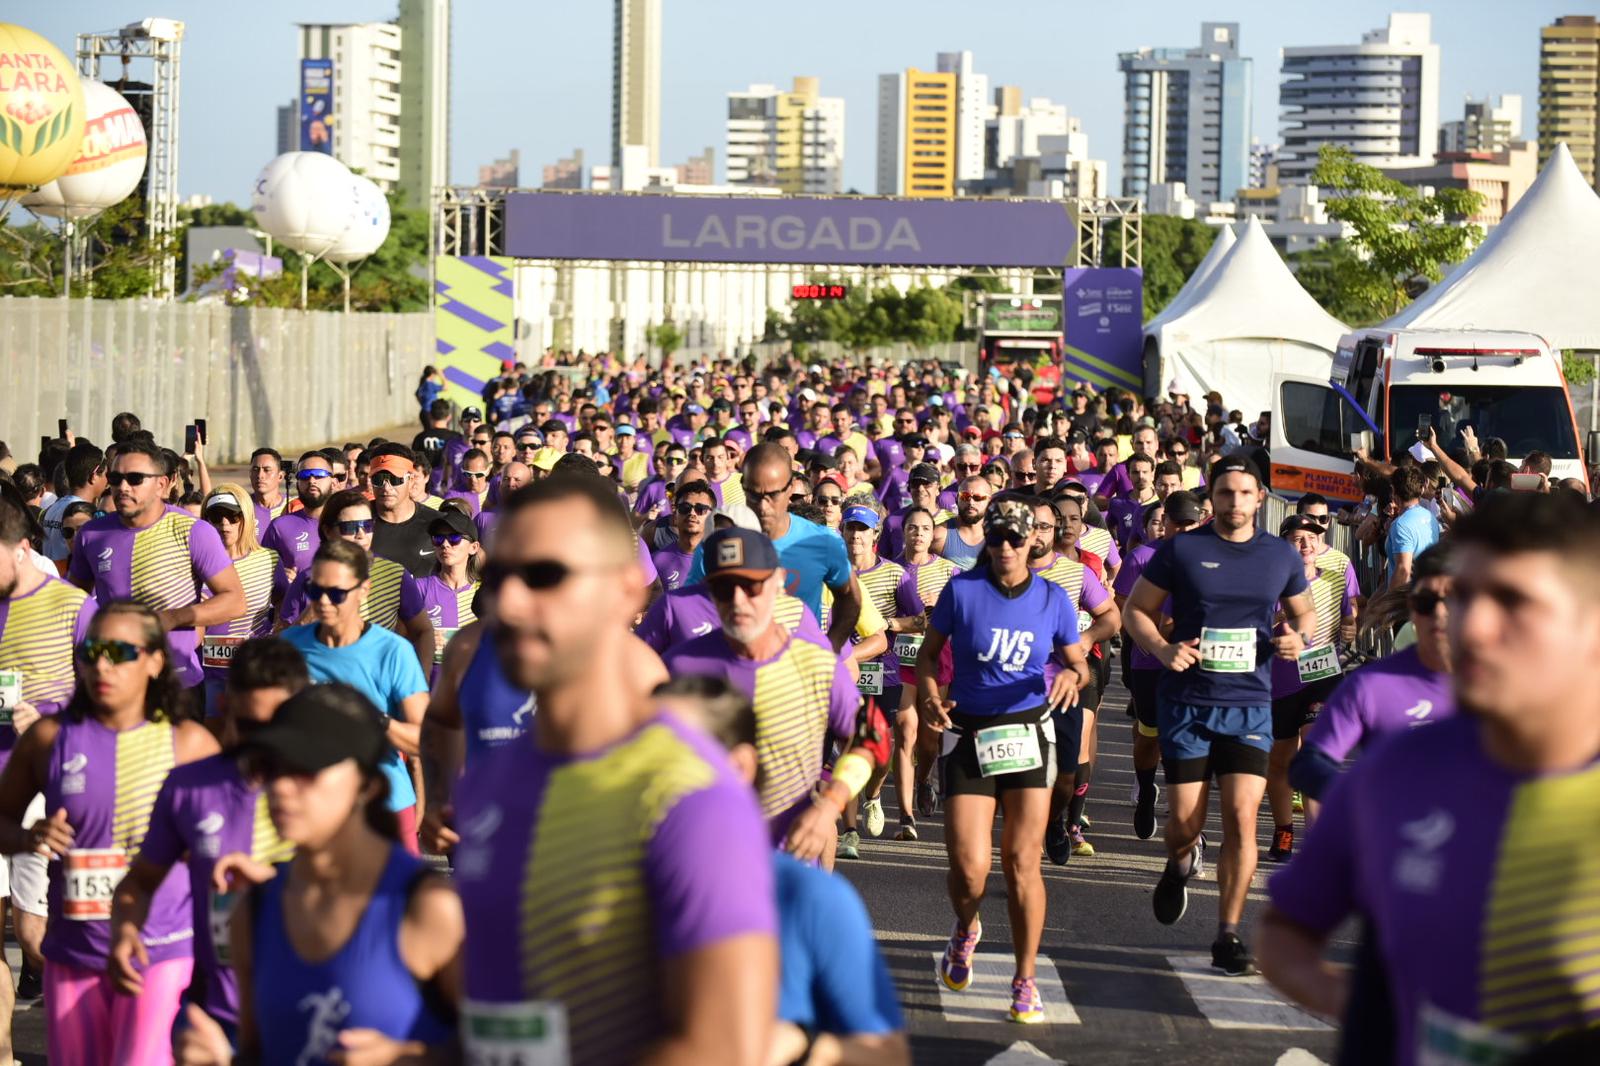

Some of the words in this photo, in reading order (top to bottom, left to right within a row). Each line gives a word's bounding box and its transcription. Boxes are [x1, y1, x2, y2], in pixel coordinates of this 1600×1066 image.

[661, 213, 922, 252] LARGADA
[1305, 472, 1345, 486] PLANTÃO
[977, 628, 1034, 666] JVS
[1210, 645, 1244, 659] 1774
[1305, 657, 1330, 672] 1471
[857, 673, 874, 685] 52
[987, 742, 1024, 760] 1567
